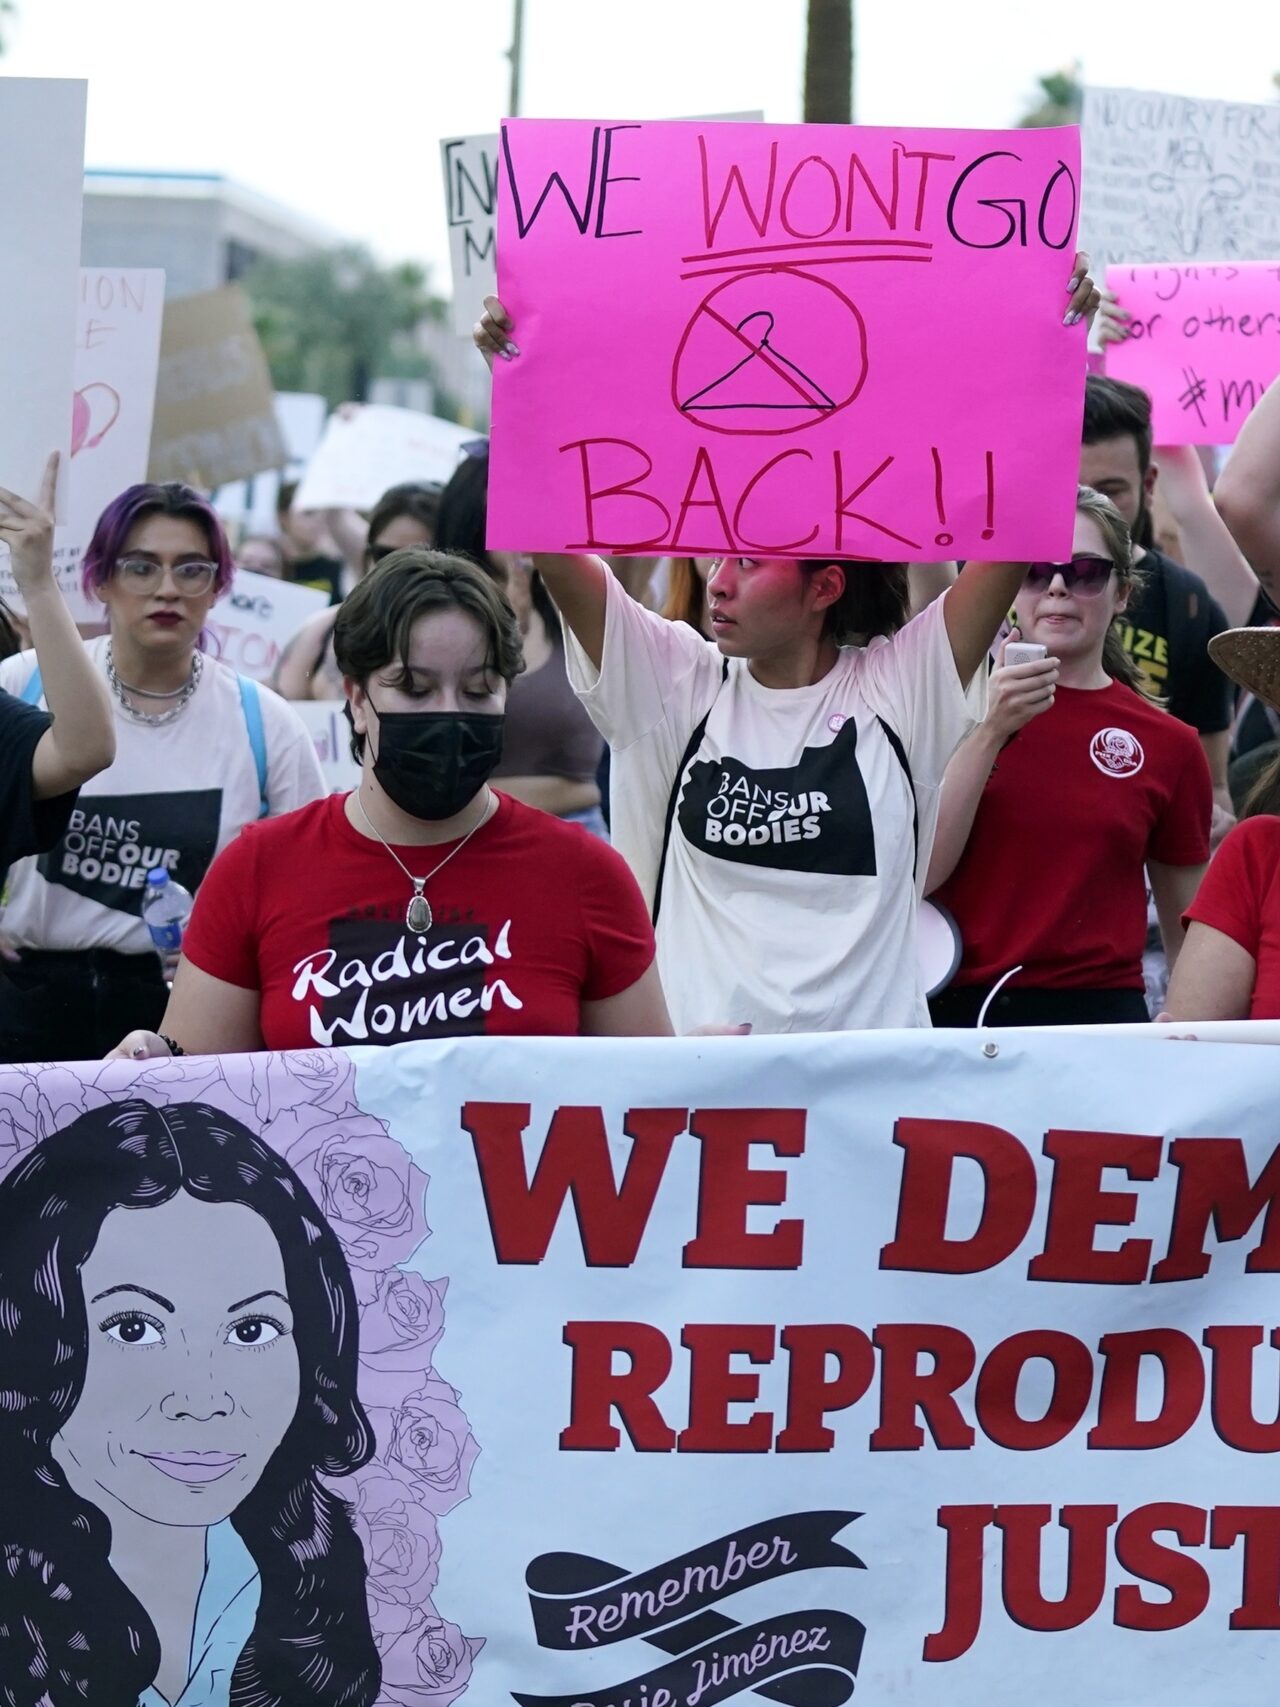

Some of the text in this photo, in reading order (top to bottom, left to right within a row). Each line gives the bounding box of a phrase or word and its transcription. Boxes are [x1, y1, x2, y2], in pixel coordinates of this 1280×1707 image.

[501, 124, 642, 239] WE
[947, 151, 1076, 249] GO
[1114, 622, 1168, 664] IZE
[707, 794, 766, 825] OFF
[718, 772, 789, 810] BANS
[68, 809, 141, 842] BANS
[705, 815, 821, 846] BODIES
[62, 853, 149, 889] BODIE
[65, 831, 181, 870] OFF OUR
[292, 919, 512, 1001] Radical
[306, 979, 523, 1047] Women
[461, 1101, 808, 1271] WE
[565, 1536, 798, 1643] Remember
[687, 1626, 831, 1706] Jiménez
